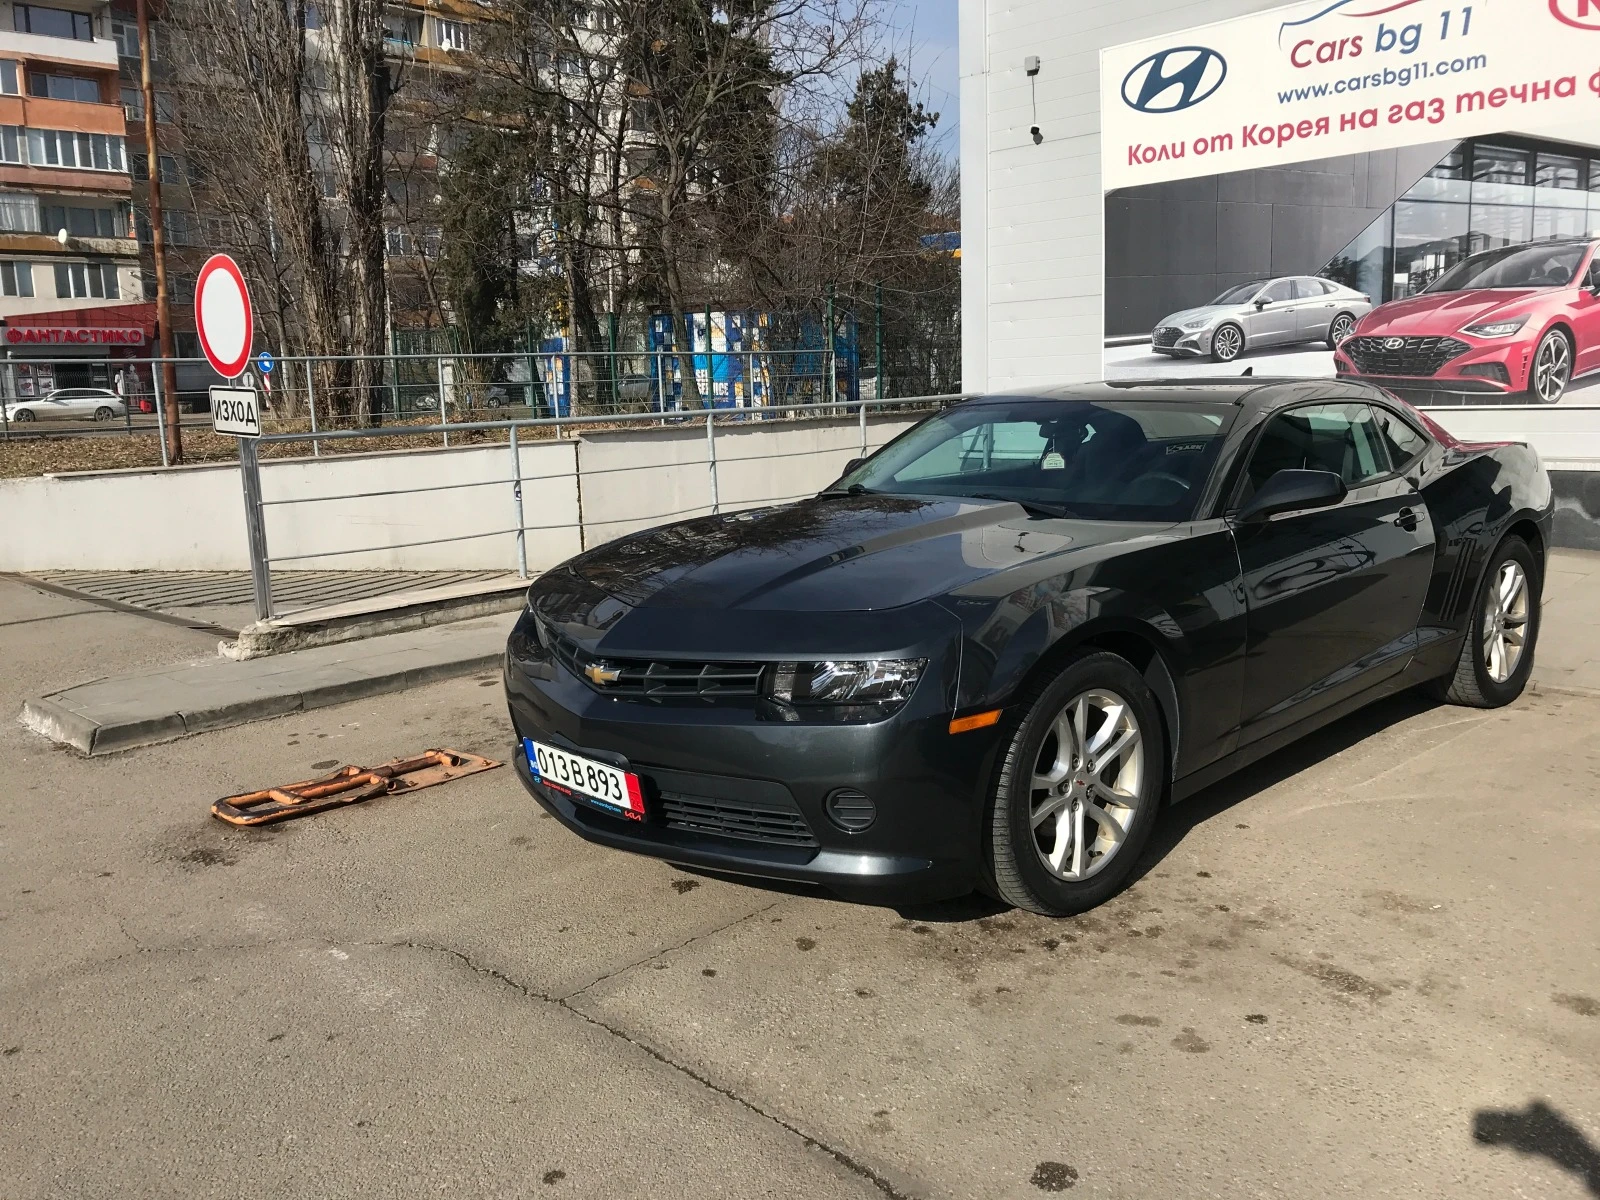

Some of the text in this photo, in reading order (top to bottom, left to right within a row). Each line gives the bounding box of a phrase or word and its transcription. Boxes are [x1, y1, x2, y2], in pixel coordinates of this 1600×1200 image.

[1289, 6, 1473, 69] Cars bg 11
[1277, 54, 1487, 105] www.carsbg11.com
[1128, 141, 1186, 166] Коли
[1193, 133, 1233, 155] от
[1242, 116, 1330, 148] Корея
[1340, 108, 1378, 132] на
[1387, 97, 1445, 124] газ
[1456, 76, 1576, 114] течна
[6, 328, 142, 344] ФАНТАСТИКО
[213, 399, 257, 427] ИЗХОД
[537, 747, 623, 801] 013B893
